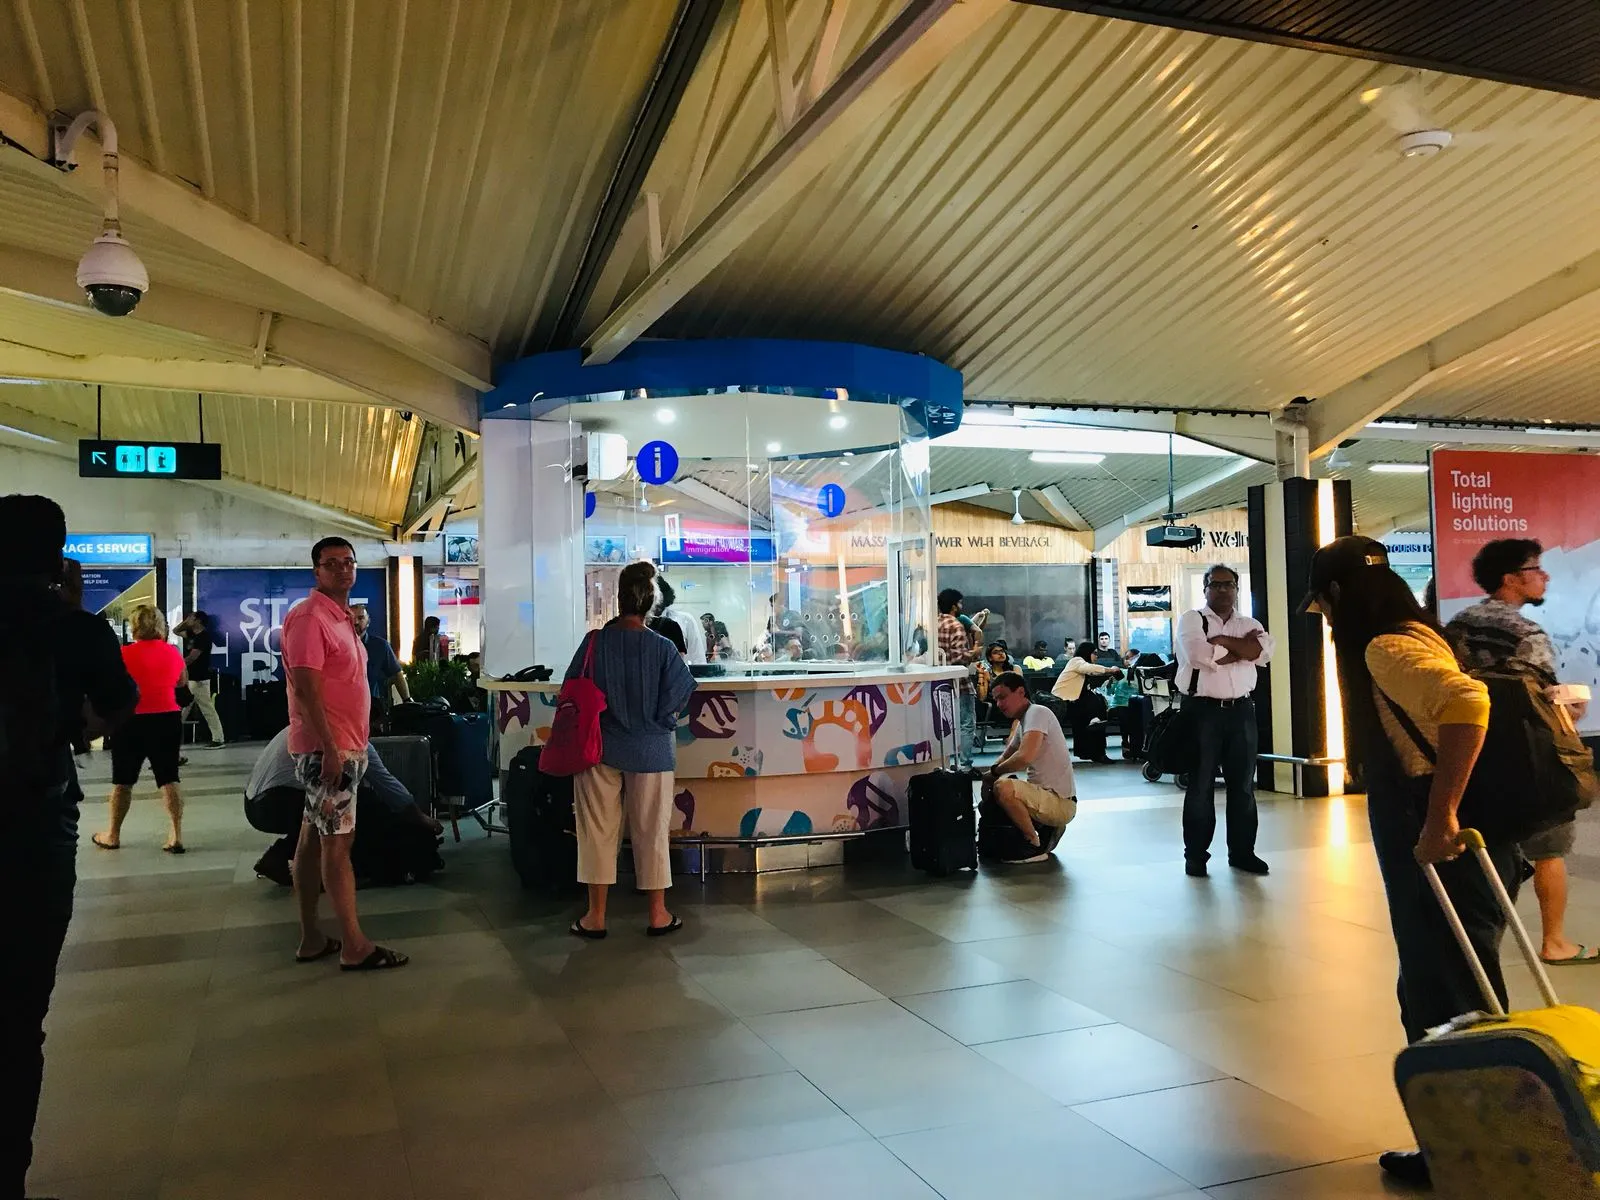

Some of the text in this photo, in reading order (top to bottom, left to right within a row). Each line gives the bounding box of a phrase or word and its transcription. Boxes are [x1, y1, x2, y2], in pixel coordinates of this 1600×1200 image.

[1450, 470, 1491, 488] Total
[1451, 492, 1513, 514] lighting
[1453, 514, 1528, 532] solutions
[96, 543, 147, 554] SERVICE
[685, 546, 730, 554] Immigration
